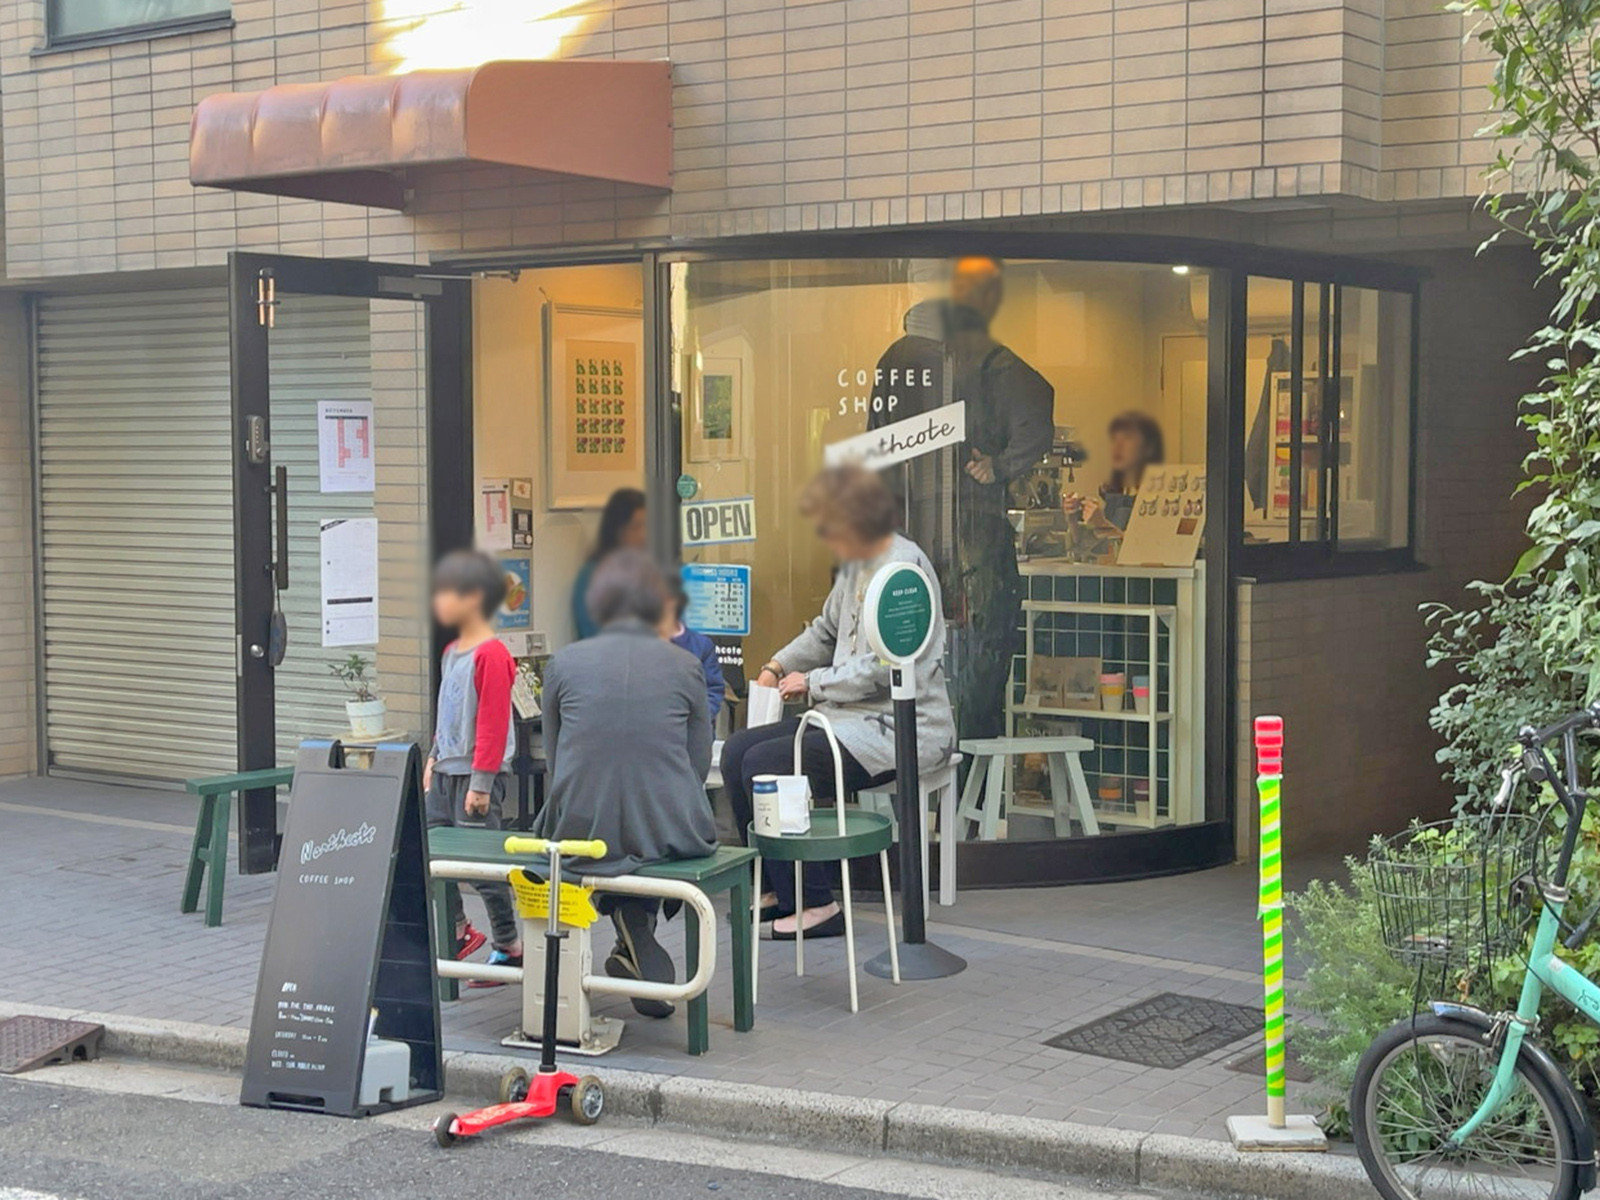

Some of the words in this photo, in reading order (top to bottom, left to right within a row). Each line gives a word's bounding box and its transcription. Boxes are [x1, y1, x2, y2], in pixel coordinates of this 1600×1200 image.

[837, 368, 933, 388] COFFEE
[837, 395, 899, 416] SHOP
[686, 503, 752, 542] OPEN
[715, 645, 742, 655] hcote
[299, 873, 329, 884] COFFEE
[334, 875, 355, 885] SHOP
